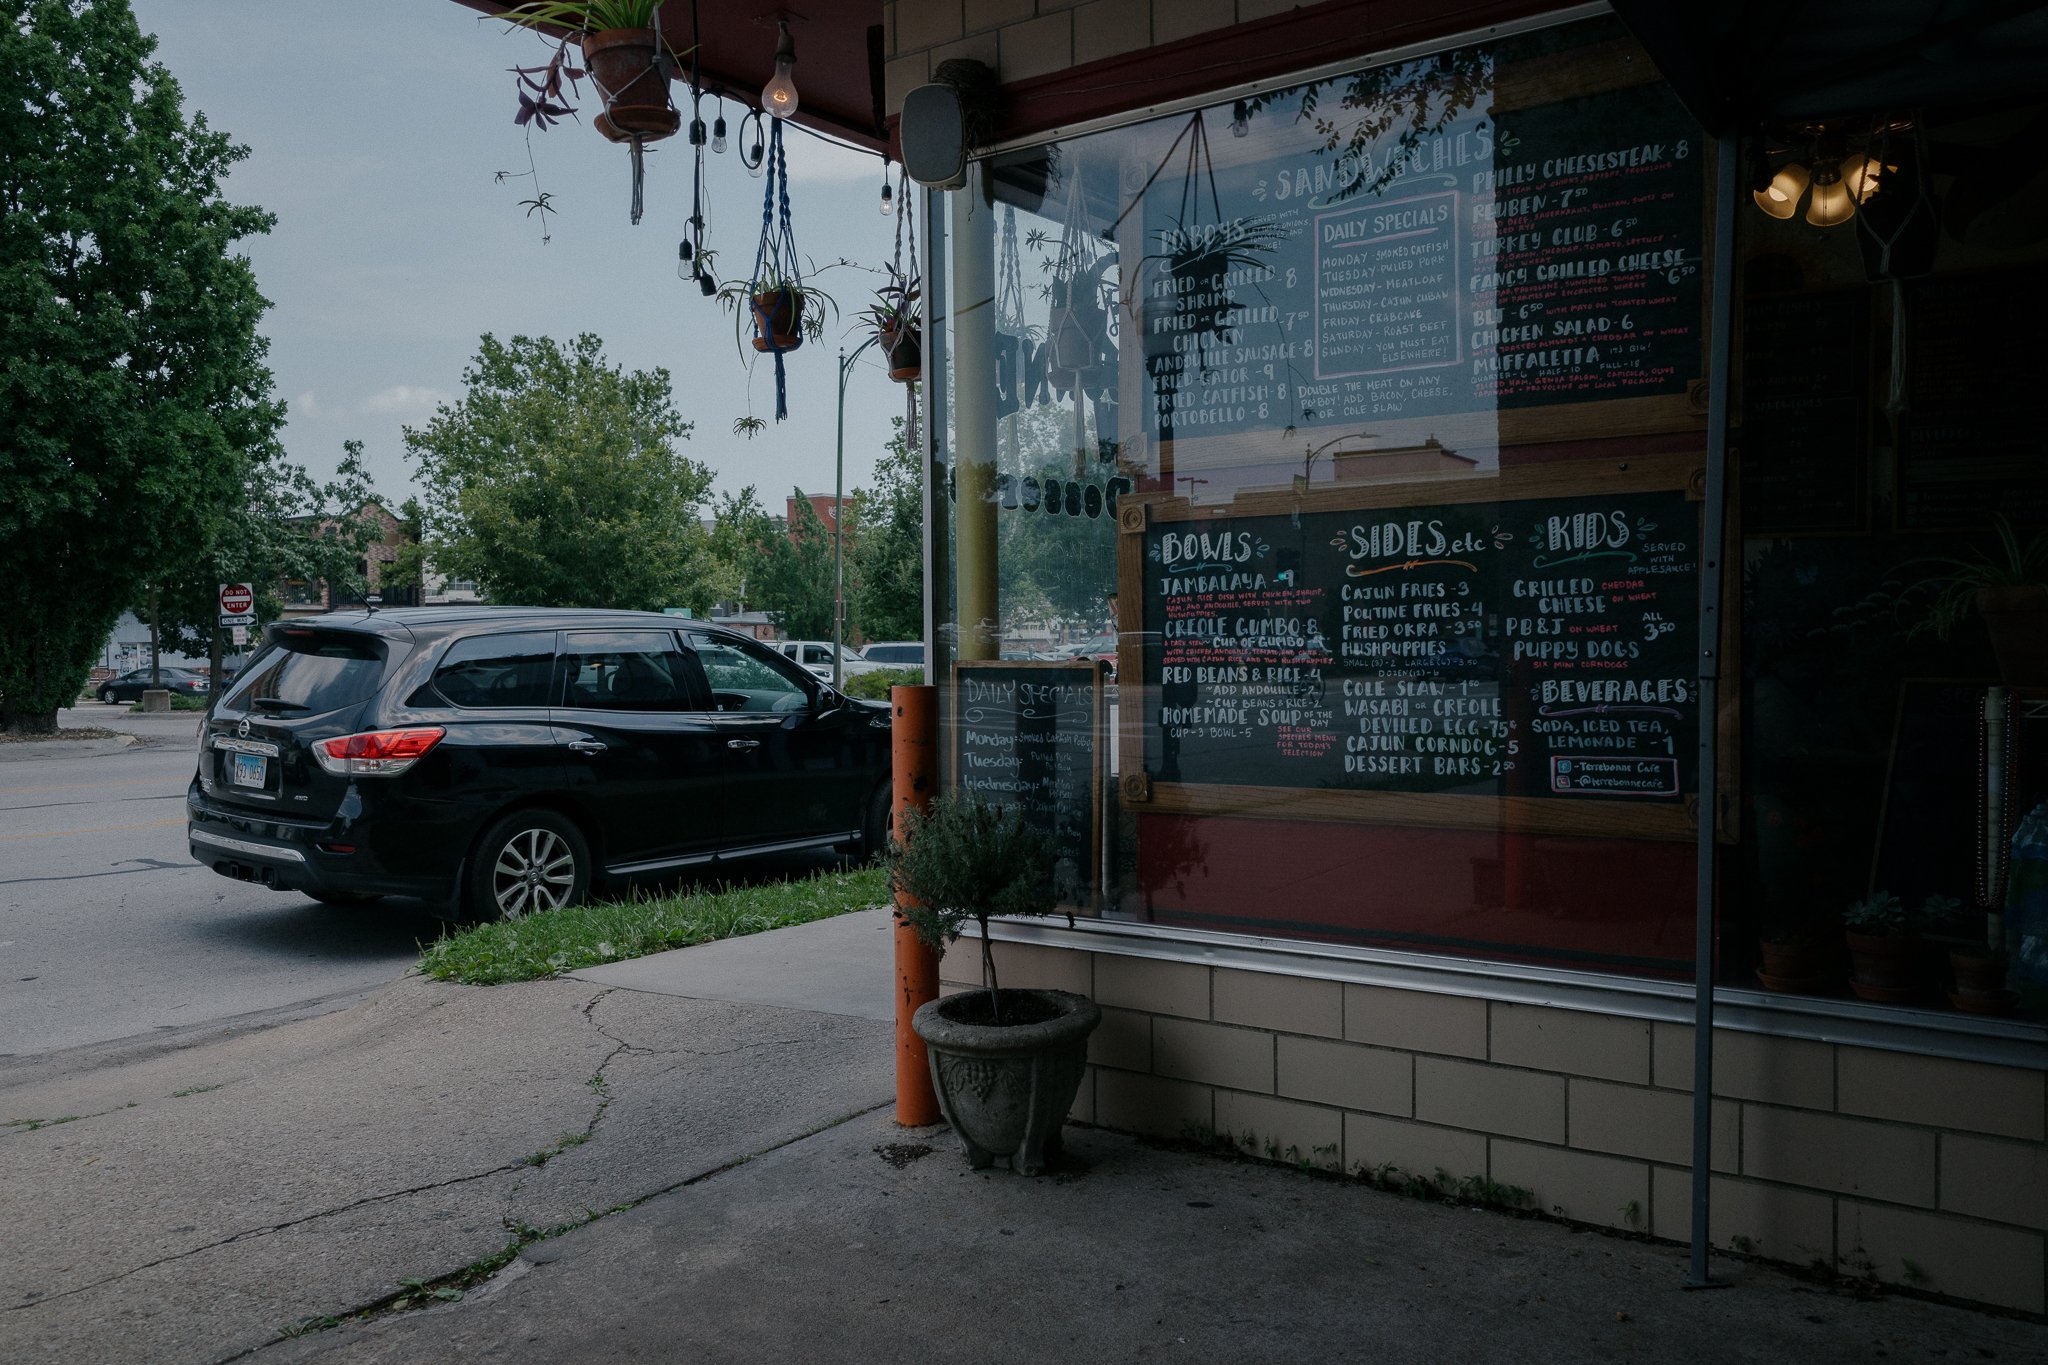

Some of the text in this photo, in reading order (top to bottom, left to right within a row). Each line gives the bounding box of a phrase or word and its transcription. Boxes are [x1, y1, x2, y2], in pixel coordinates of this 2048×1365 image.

[1275, 129, 1494, 201] SANDWICHES
[1472, 143, 1666, 194] PHILLY CHEESESTEAK
[1280, 209, 1299, 219] WITH
[1472, 194, 1548, 224] REUBEN
[1324, 219, 1367, 244] DAILY
[1374, 205, 1448, 234] SPECIALS
[1470, 224, 1598, 259] TURKEY CLUB
[1322, 240, 1449, 270] MONDAY CATFISH
[1322, 255, 1445, 284] TUESDAY PORK
[1470, 248, 1686, 294] FANCY GRILLED CHEESE
[1153, 265, 1276, 298] FRIED GRILLED
[1386, 274, 1444, 290] MEATLOAF
[1176, 289, 1236, 312] SHRIMP
[1380, 290, 1449, 308] CAJUN CUBAN
[1153, 313, 1196, 334] FRIED
[1214, 305, 1280, 326] GRILLED
[1369, 310, 1423, 324] CRABCAKE
[1472, 307, 1505, 328] BLT
[1173, 328, 1244, 353] CHICKEN
[1322, 320, 1448, 344] SATURDAY ROAST BEEF
[1470, 316, 1611, 350] CHICKEN SALAD
[1322, 336, 1450, 358] SUNDAY YOU MUST EAT
[1382, 346, 1448, 364] ELSEWHERE!
[1154, 341, 1297, 374] ANDOUILLE SAUSAGE
[1473, 346, 1601, 375] MUFFALETTA
[1152, 367, 1250, 392] FRIED GATOR
[1297, 374, 1440, 398] DOUBLE THE MEAT ON ANY
[1153, 384, 1268, 412] FRIED CATFISH
[1343, 394, 1364, 406] ADD
[1370, 390, 1407, 402] BACON,
[1153, 406, 1245, 430] PORTOBELLO
[1319, 402, 1402, 419] OR COLE SLAW
[1548, 510, 1630, 552] KIDS
[1162, 532, 1252, 565] BOWLS
[1642, 542, 1686, 553] SERVED
[1650, 554, 1674, 563] WITH
[1627, 564, 1696, 575] APPLESAUCE!
[1160, 573, 1267, 596] JAMBALAYA
[1341, 582, 1446, 602] CAJUN FRIES
[1513, 578, 1646, 598] GRILLED CHEDDAR
[1166, 595, 1193, 604] CAJUN
[1238, 592, 1257, 600] WITH
[1538, 592, 1658, 614] CHEESE ON WHEAT
[1343, 602, 1460, 622] POUTINE FRIES
[1642, 612, 1663, 621] ALL
[1164, 616, 1300, 638] CREOLE GUMBO
[1342, 622, 1439, 640] FRIED OKRA
[1568, 624, 1619, 634] ON WHEAT
[1212, 636, 1238, 648] CUP
[1240, 636, 1254, 648] OF
[1260, 636, 1305, 648] GUMBO
[1342, 640, 1447, 657] HUSHPUPPIES
[1514, 640, 1640, 661] PUPPY DOGS
[1580, 660, 1629, 668] CORNDOGS
[1162, 666, 1302, 684] RED BEANS & RICE
[964, 678, 1094, 706] DAILY SPECIALS
[1242, 686, 1299, 696] ANDOUILLE
[1343, 680, 1445, 696] COLE SLAW
[1542, 678, 1688, 704] BEVERAGES
[1242, 699, 1306, 709] BEANS RICE
[1344, 698, 1502, 717] WASABI OR CREOLE
[1162, 706, 1248, 725] HOMEMADE
[1257, 709, 1301, 726] SOUP
[1318, 710, 1333, 718] THE
[1310, 718, 1329, 728] DAY
[1296, 726, 1312, 734] OUR
[1360, 718, 1480, 736] DEVILED EGG
[1531, 718, 1670, 735] SODA, ICED TEA,
[1046, 732, 1072, 744] Catfish
[1276, 740, 1293, 748] FOR
[1278, 734, 1337, 742] SPECIALS MENU
[1346, 735, 1498, 756] CAJUN CORNDOG
[1548, 735, 1638, 750] LEMONADE
[1282, 749, 1324, 758] SELECTION
[963, 751, 1024, 778] Tuesday:
[1344, 754, 1481, 776] DESSERT BARS
[1637, 761, 1661, 774] Cafe
